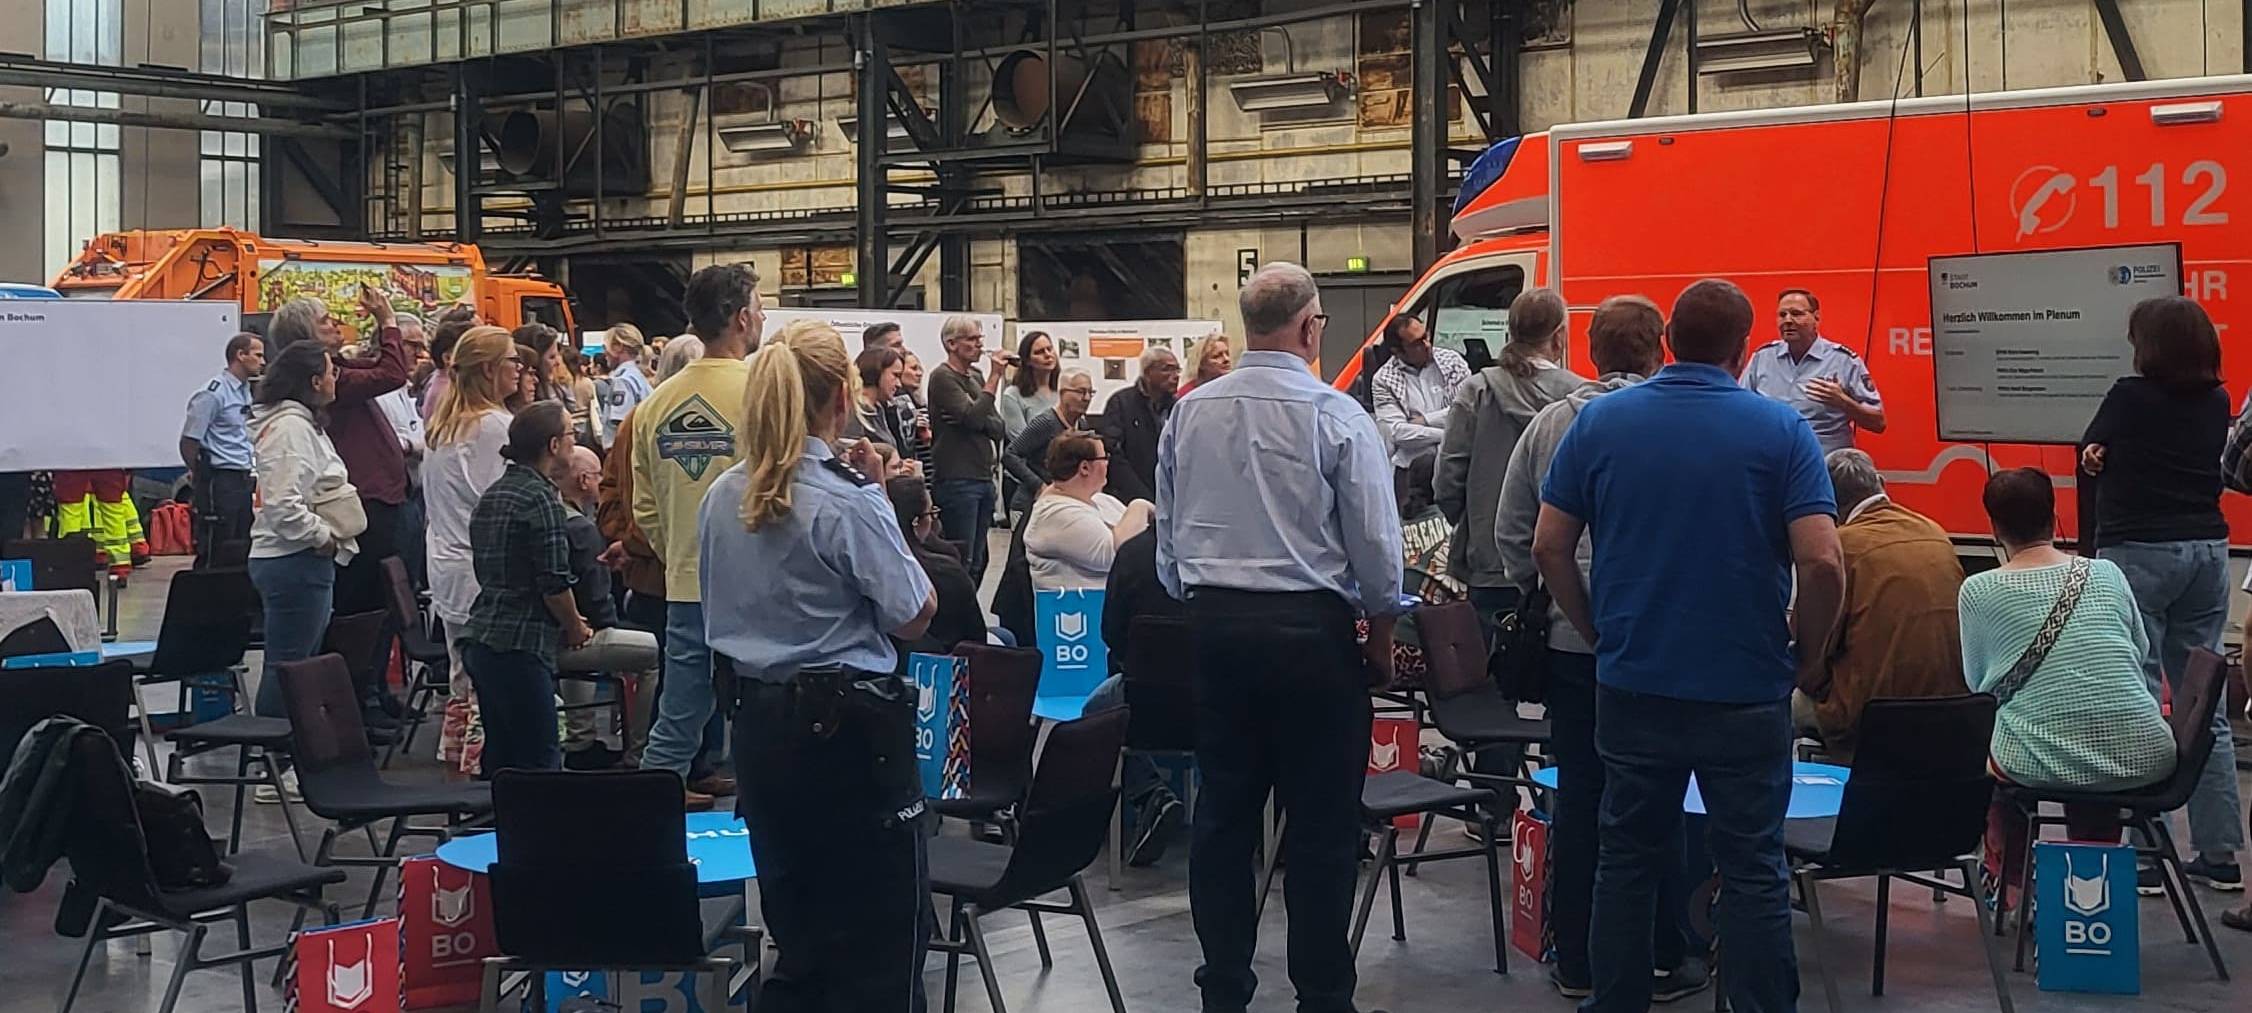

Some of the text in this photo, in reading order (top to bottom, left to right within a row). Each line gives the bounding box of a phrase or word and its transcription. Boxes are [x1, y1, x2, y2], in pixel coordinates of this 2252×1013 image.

[2088, 160, 2229, 229] 112
[1241, 252, 1255, 285] 5
[7, 313, 45, 321] Bochum
[1943, 309, 2081, 323] Herzlich Willkommen im Plenum
[1056, 645, 1088, 661] BO
[1519, 885, 1533, 910] BO
[432, 932, 476, 957] BO
[2065, 921, 2112, 944] BO
